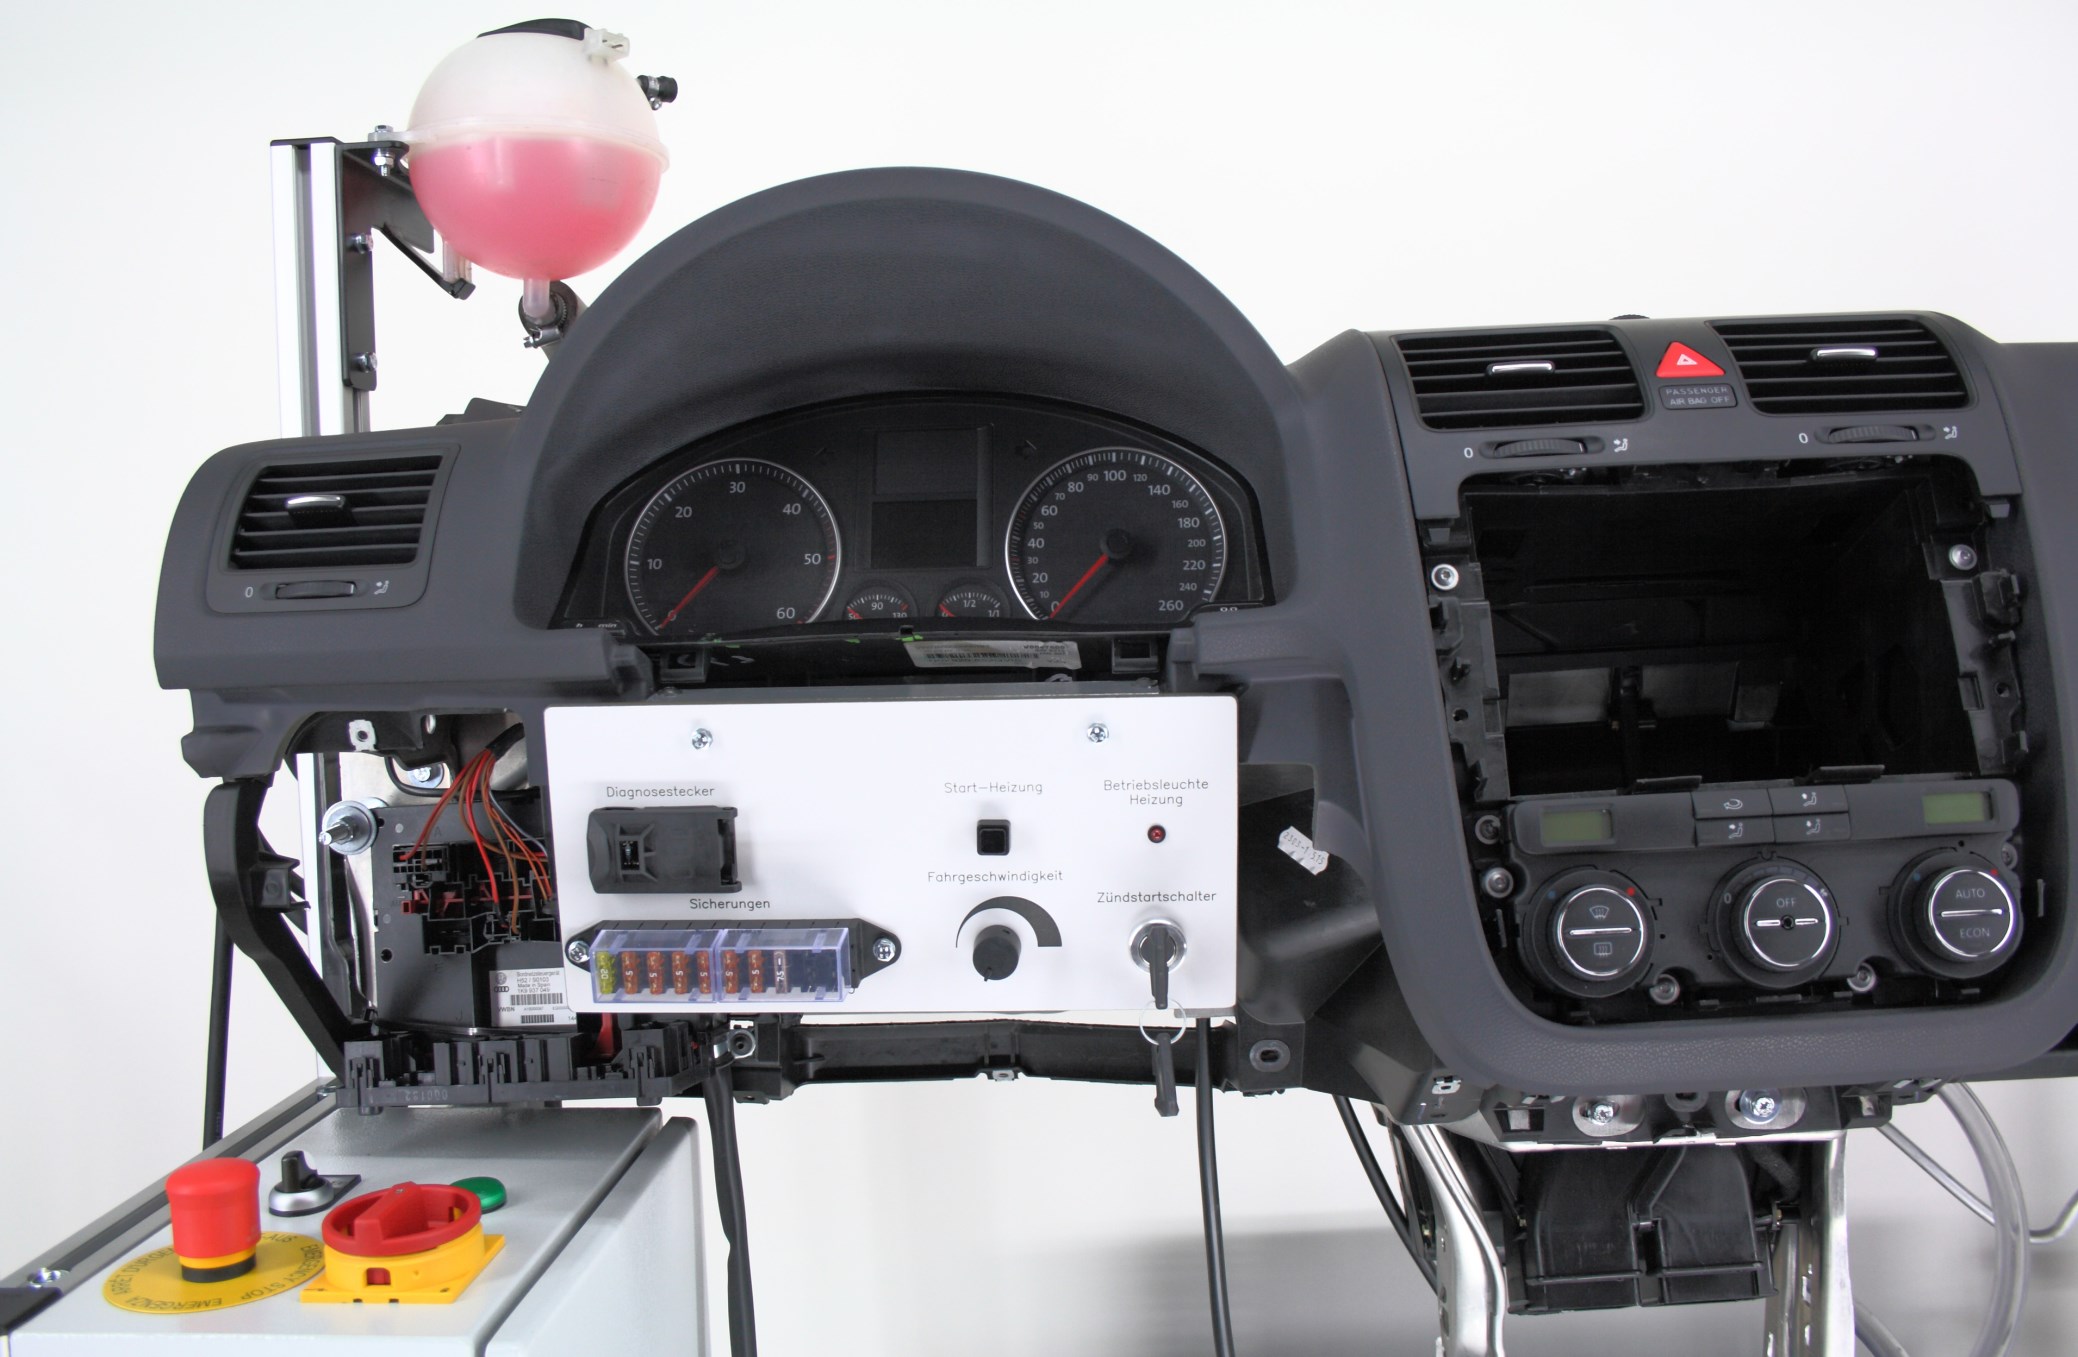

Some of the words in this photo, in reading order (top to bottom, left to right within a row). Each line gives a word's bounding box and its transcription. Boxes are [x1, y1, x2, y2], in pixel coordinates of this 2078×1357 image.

[1665, 386, 1728, 395] PASSENGER
[1687, 397, 1707, 405] BAG
[1087, 473, 1098, 481] 90
[1103, 470, 1126, 482] 100
[1133, 473, 1148, 482] 120
[729, 481, 746, 493] 30
[1067, 481, 1084, 493] 80
[1148, 484, 1171, 496] 140
[782, 503, 801, 515] 40
[1172, 500, 1189, 508] 160
[675, 506, 692, 518] 20
[1041, 505, 1058, 516] 60
[1033, 522, 1044, 530] 50
[1178, 517, 1200, 528] 180
[1028, 538, 1045, 549] 40
[1187, 538, 1206, 547] 200
[647, 558, 662, 570] 10
[804, 553, 821, 565] 50
[1027, 556, 1038, 564] 30
[1183, 559, 1206, 571] 220
[1032, 572, 1048, 583] 20
[1179, 583, 1197, 592] 240
[1040, 590, 1049, 599] 10
[871, 602, 884, 611] 90
[963, 599, 976, 608] 1/2
[1158, 600, 1183, 611] 260
[776, 607, 795, 619] 60
[988, 609, 1000, 617] 1/1
[943, 781, 1043, 794] Start-Heizung
[1104, 778, 1209, 791] Betriebsleuchte
[606, 785, 715, 800] Diagnosestecker
[1129, 794, 1184, 807] Heizung
[927, 870, 1064, 884] Fahrgeschwindigkeit
[1097, 890, 1217, 903] Zündstartschalter
[1955, 888, 1986, 898] AUTO
[689, 898, 771, 911] Sicherungen
[1776, 898, 1797, 908] OFF
[1959, 928, 1991, 938] ECON
[241, 1282, 286, 1300] STOP
